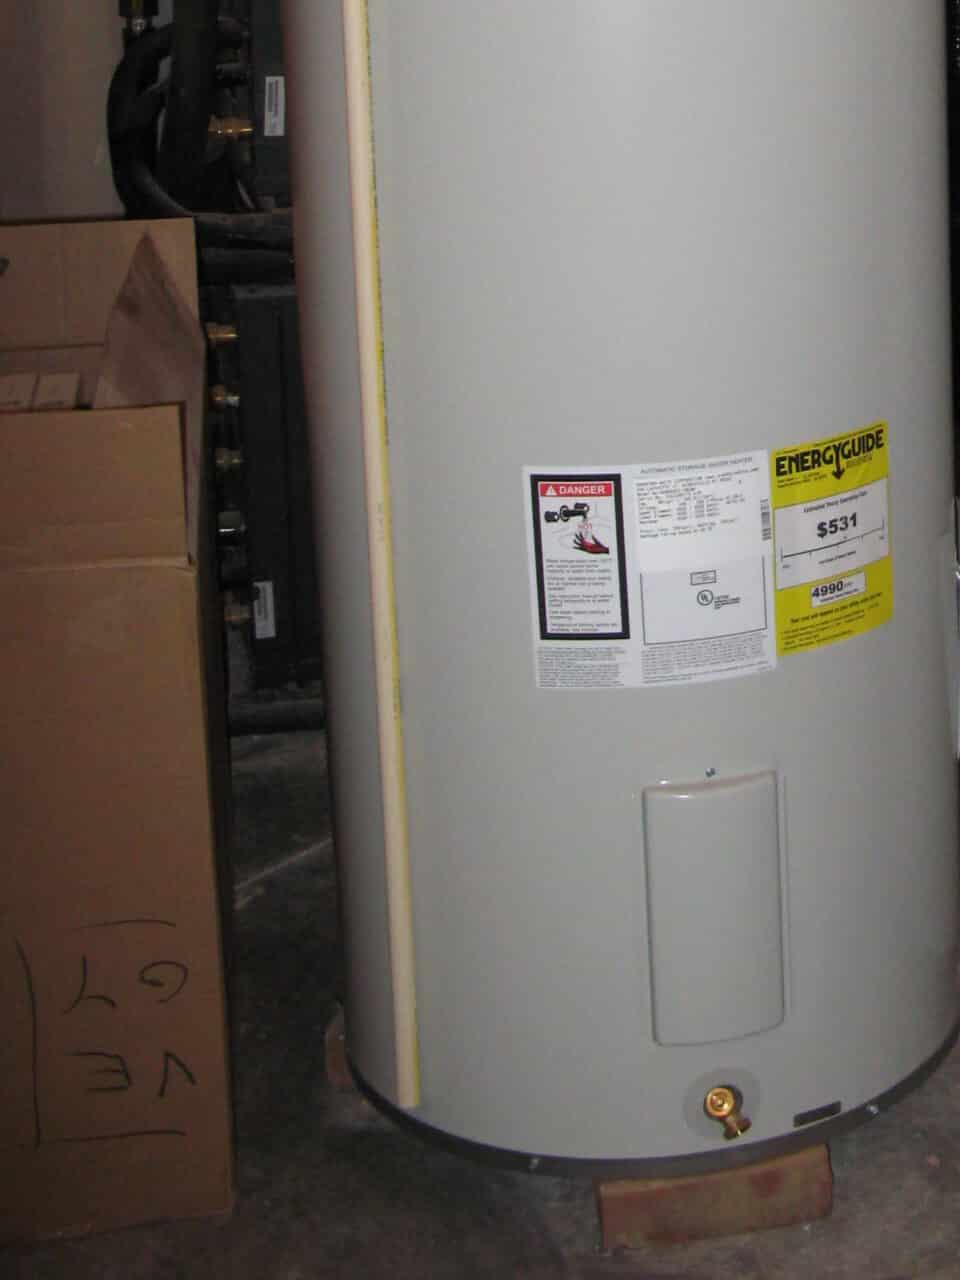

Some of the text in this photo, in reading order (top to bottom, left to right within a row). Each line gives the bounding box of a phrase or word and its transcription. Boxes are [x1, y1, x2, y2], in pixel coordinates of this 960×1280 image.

[775, 428, 884, 479] ENERGYGUIDE
[559, 485, 606, 495] DANGER
[817, 512, 857, 538] $531
[812, 581, 844, 598] 4990
